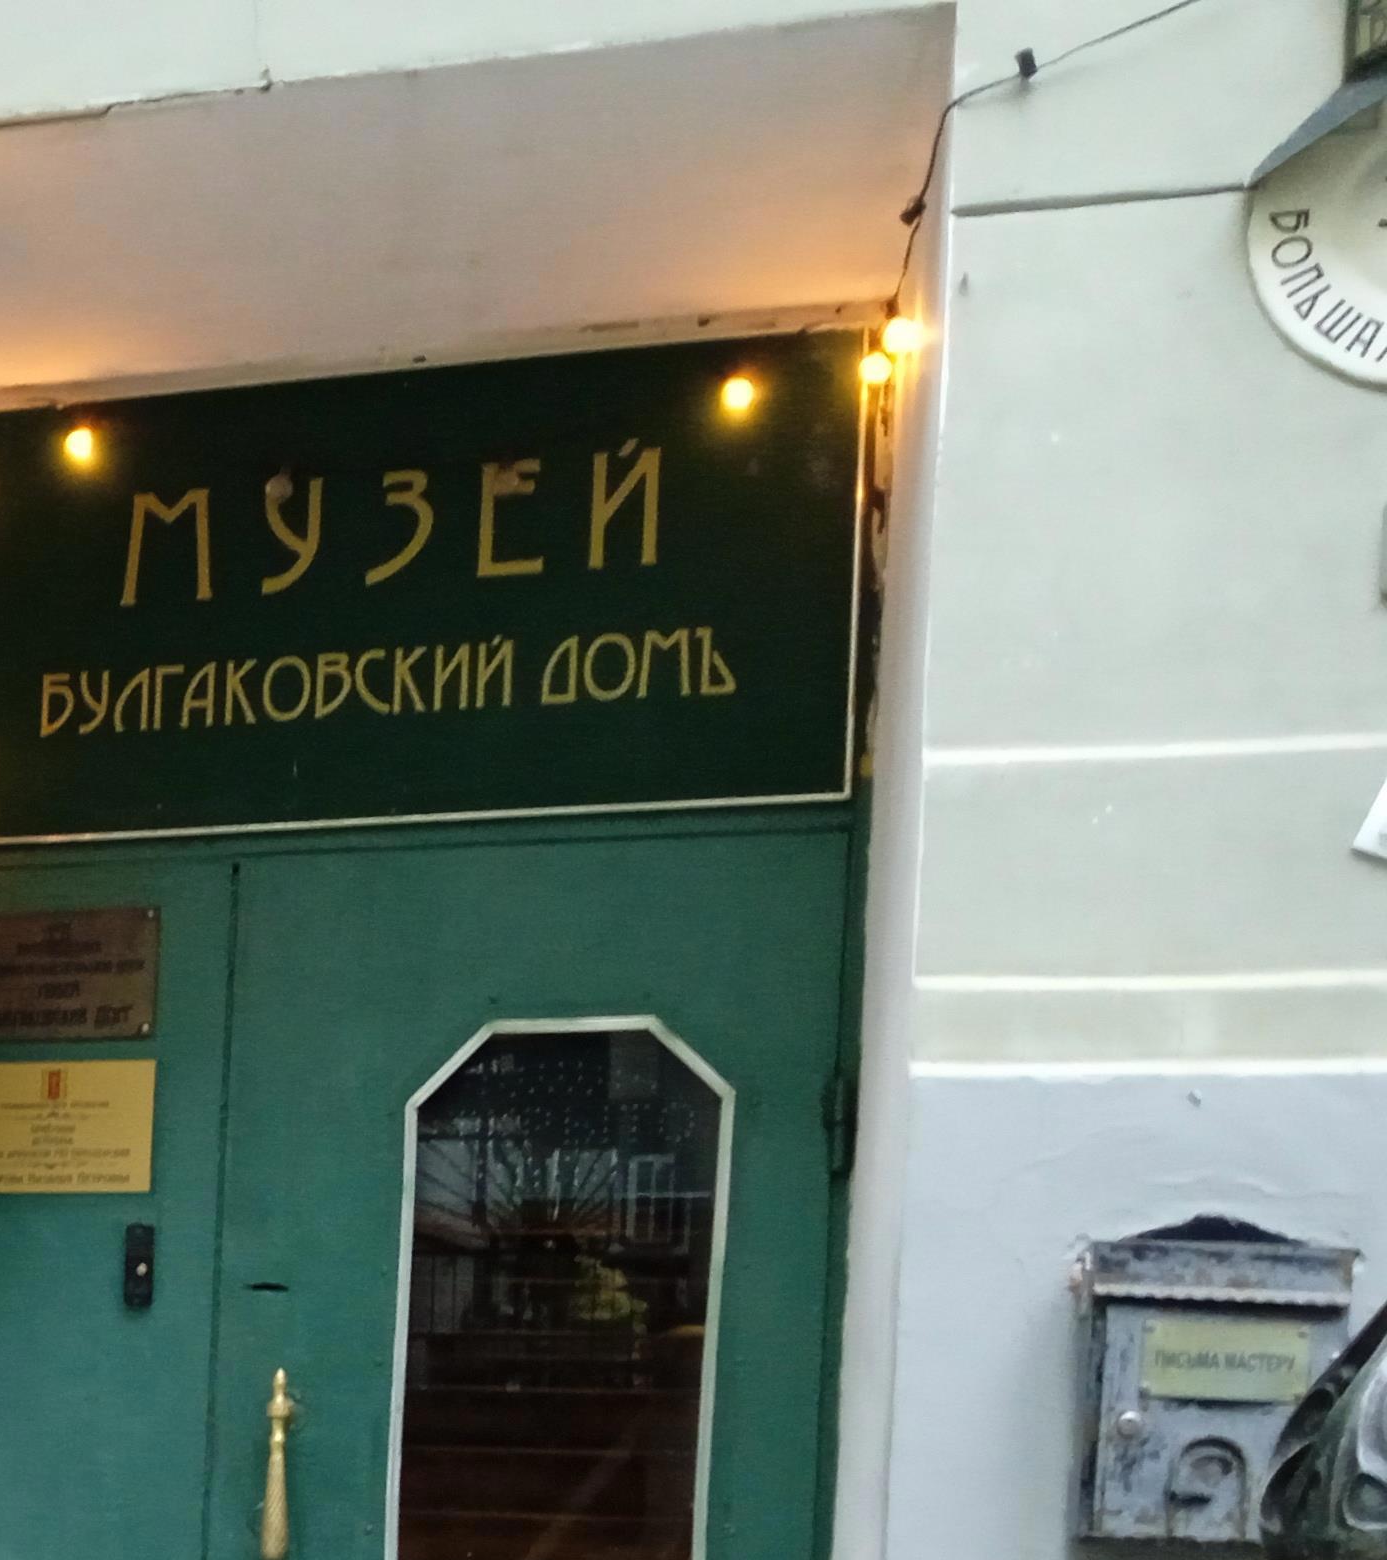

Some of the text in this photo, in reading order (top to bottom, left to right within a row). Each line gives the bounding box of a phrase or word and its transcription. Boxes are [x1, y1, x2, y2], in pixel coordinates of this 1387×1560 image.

[1269, 208, 1387, 363] БОЛЬША
[120, 438, 664, 607] МУЗЕЙ
[38, 626, 737, 738] БУЛГАКОВСКИЙ ДОМЪ
